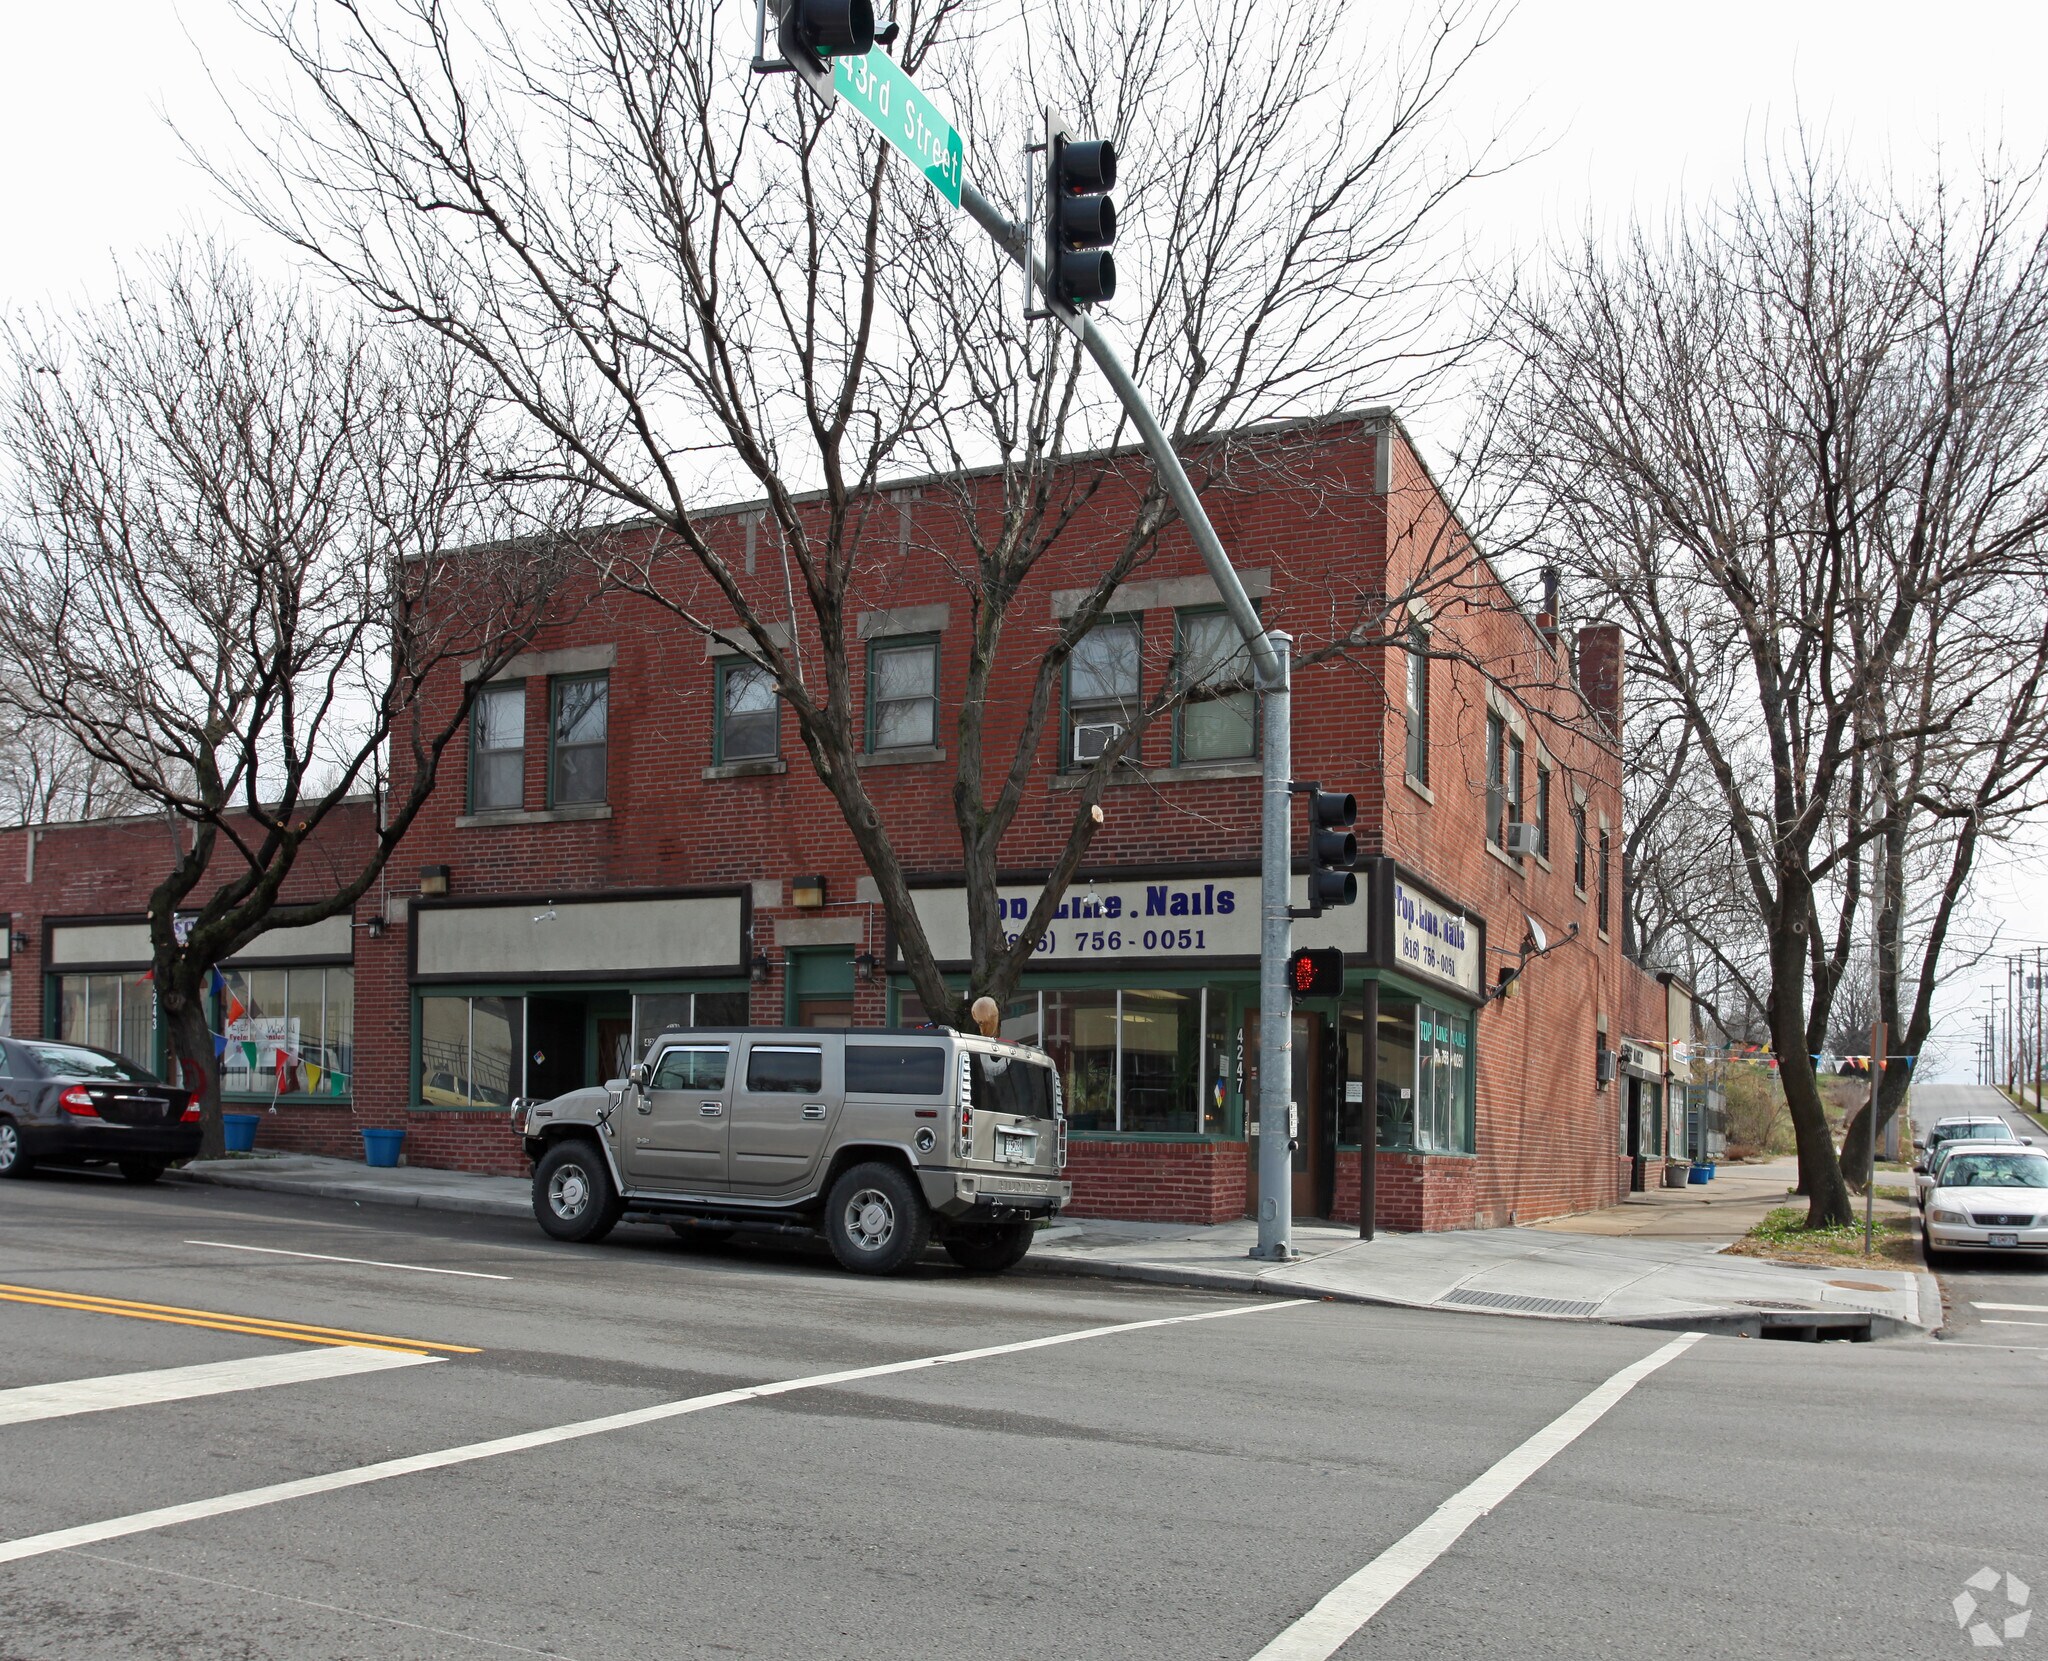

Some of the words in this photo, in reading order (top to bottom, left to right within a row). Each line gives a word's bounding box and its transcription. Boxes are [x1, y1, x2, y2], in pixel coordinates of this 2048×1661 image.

[839, 55, 890, 118] 43rd
[904, 99, 958, 187] Street
[1236, 1028, 1244, 1094] 4247
[1420, 1020, 1432, 1042] TOP
[1436, 1025, 1449, 1043] LINE
